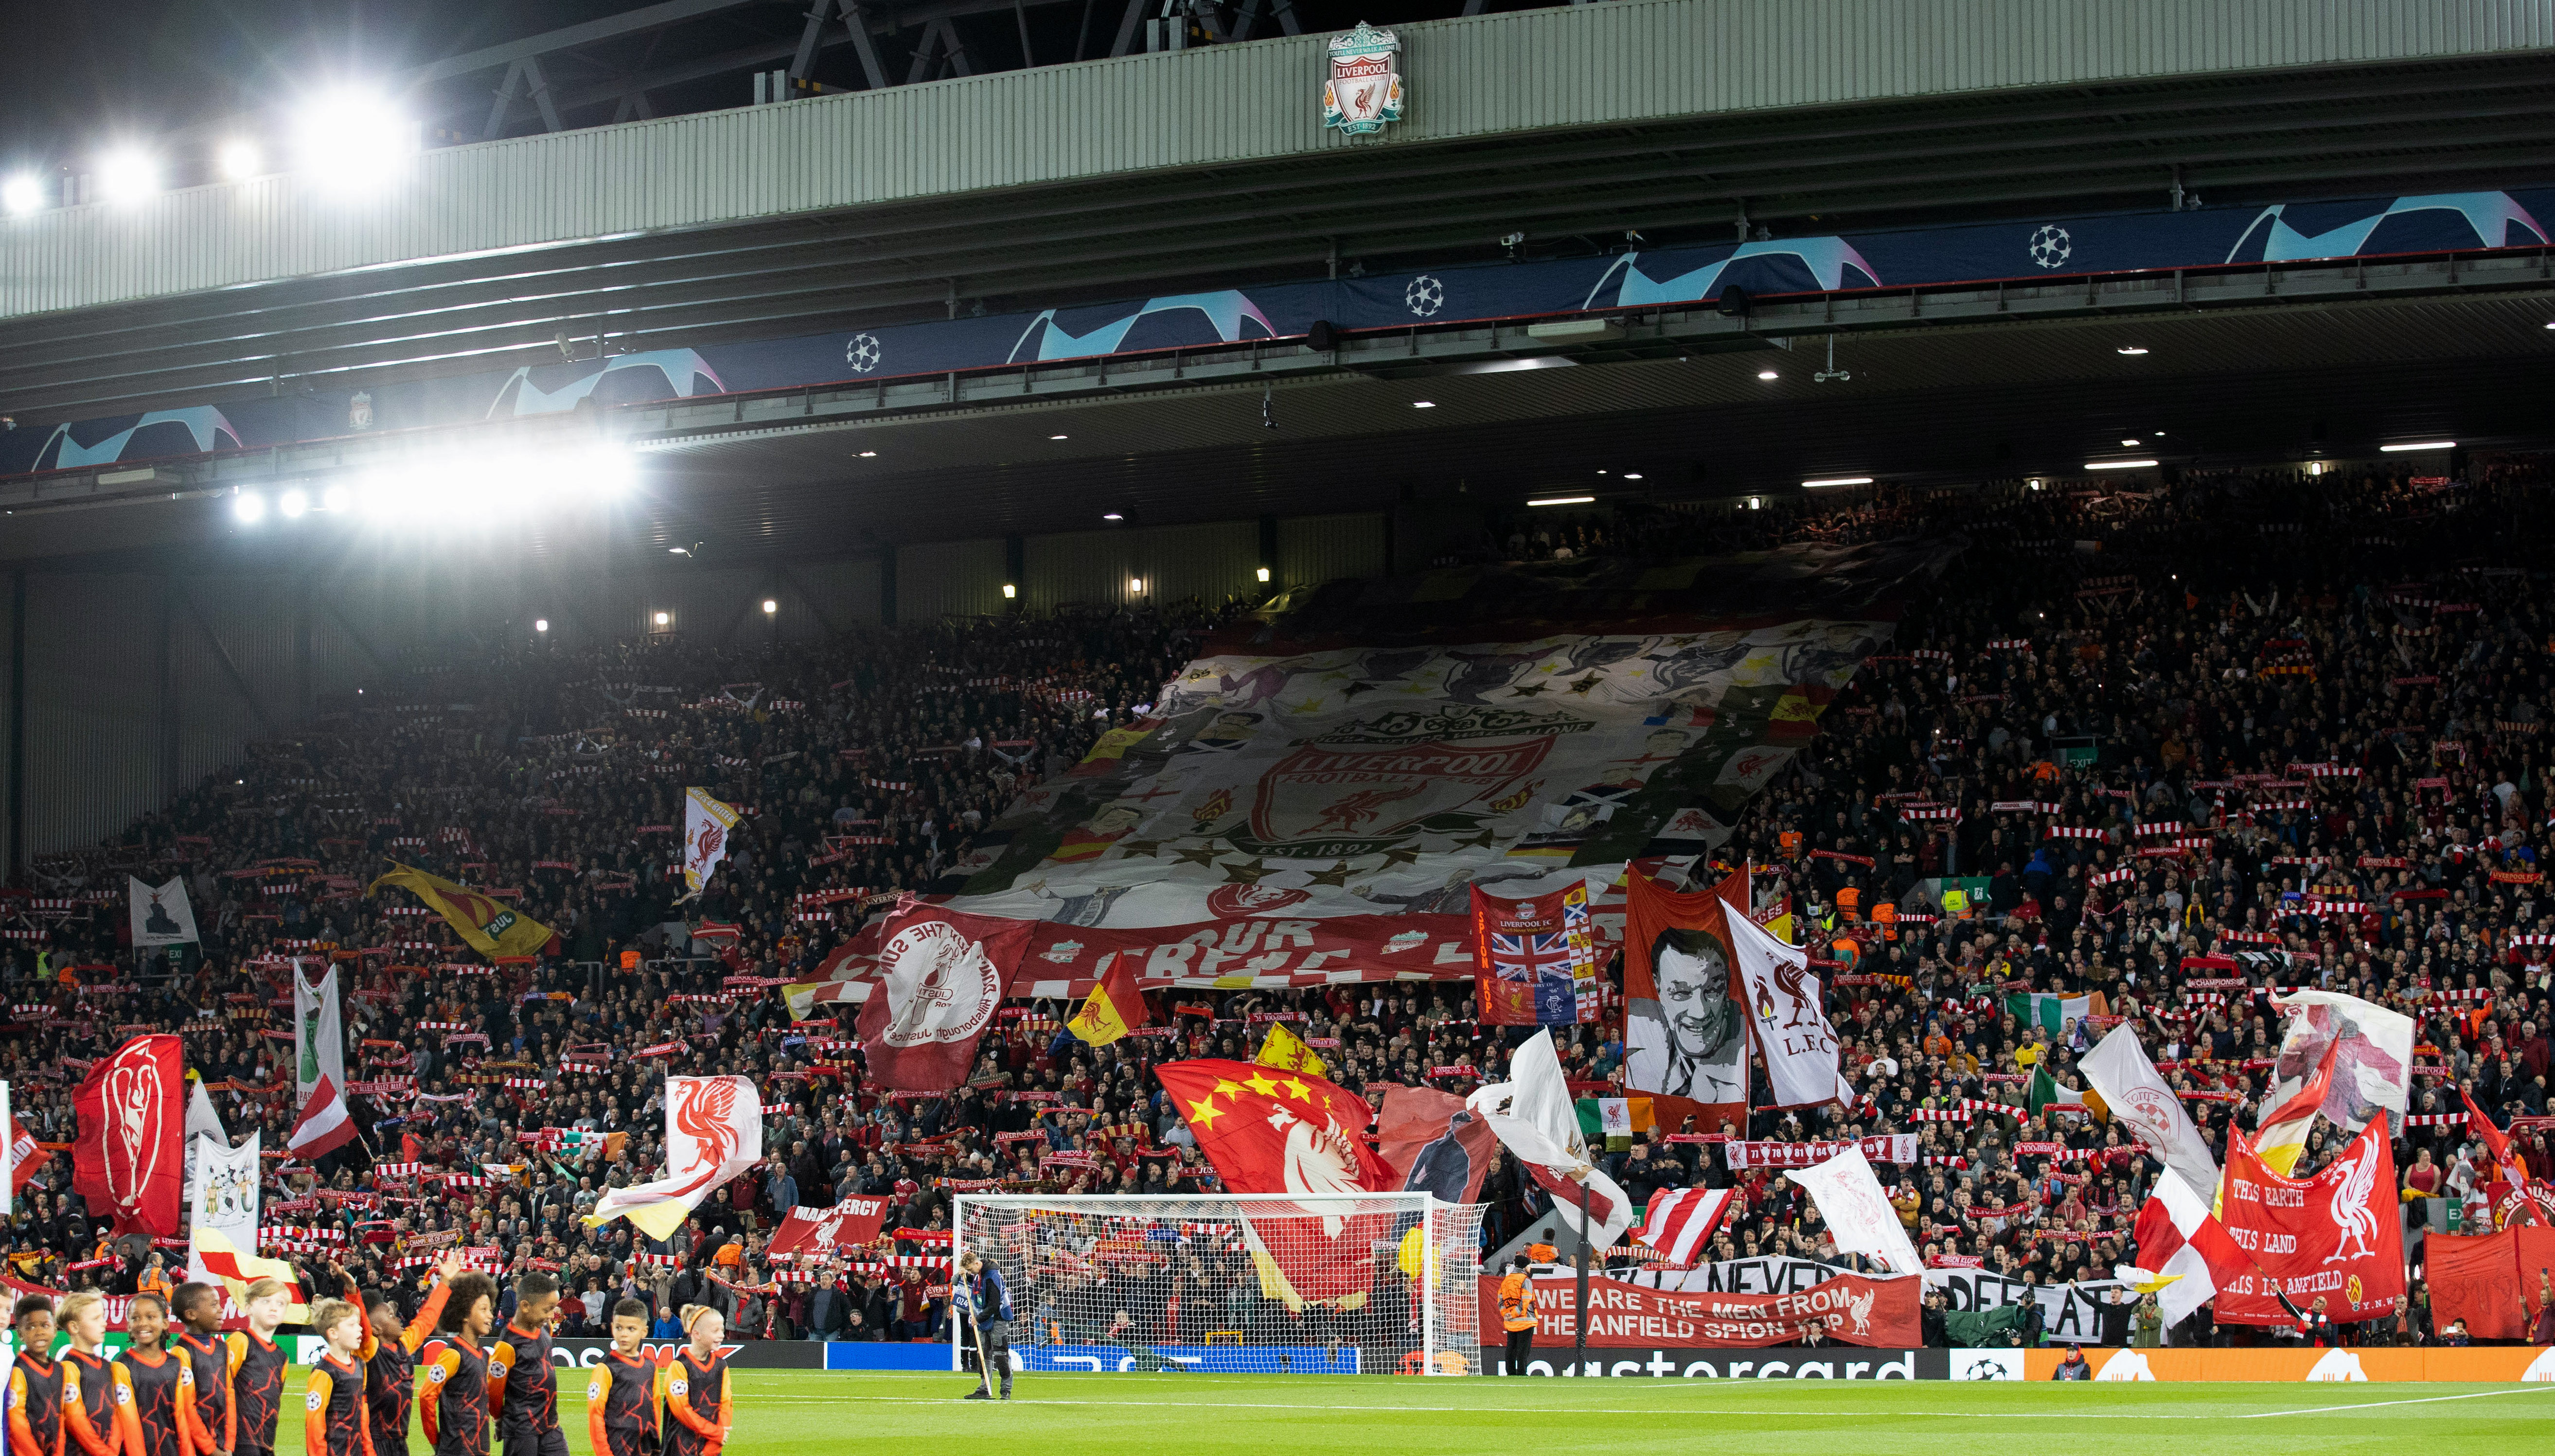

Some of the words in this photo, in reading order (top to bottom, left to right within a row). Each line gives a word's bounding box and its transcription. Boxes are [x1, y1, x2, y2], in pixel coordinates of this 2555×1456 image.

[1363, 46, 1378, 54] WALK
[1378, 44, 1396, 52] ALONE
[1337, 64, 1387, 78] LIVERPOOL
[1339, 77, 1369, 86] FOOTBALL
[1522, 722, 1592, 735] ALONE
[1292, 751, 1523, 774] LIVERPOOL
[2069, 759, 2093, 768] EXIT
[1283, 773, 1416, 784] FOOTBALL
[1816, 850, 1858, 860] LIVERPOOL
[1477, 911, 1490, 969] SPION
[169, 949, 182, 958] EXI
[1482, 978, 1493, 1014] KOP
[643, 1044, 672, 1054] ROBERTSON
[1783, 1033, 1832, 1057] L.F.C
[64, 1056, 93, 1068] LIVERPOOL
[390, 1082, 405, 1090] ALLEZ
[892, 1090, 926, 1098] LIVERPOOL
[998, 1131, 1035, 1140] LIVERPOOL
[1751, 1150, 1759, 1158] 77
[1772, 1149, 1782, 1158] 78
[1794, 1148, 1804, 1157] 81
[1816, 1147, 1827, 1157] 84
[1864, 1143, 1875, 1153] 19
[318, 1188, 355, 1198] LIVERPOOL
[2233, 1178, 2260, 1202] THIS
[2265, 1187, 2304, 1208] EARTH
[277, 1200, 305, 1208] LIVERPOOL
[834, 1199, 882, 1216] PERCY
[1975, 1205, 2025, 1215] LIVERPOOL
[410, 1236, 435, 1246] CHAMPIONS
[442, 1232, 458, 1241] EUROPE
[2230, 1226, 2258, 1250] THIS
[2263, 1232, 2296, 1254] LAND
[72, 1259, 103, 1269] LIVERPOOL
[1707, 1261, 1835, 1294] NEVER
[2223, 1275, 2253, 1296] HIS
[2262, 1277, 2278, 1297] IS
[2287, 1270, 2342, 1296] ANFIELD
[1534, 1288, 1575, 1310] WE
[1588, 1288, 1643, 1311] ARE
[1653, 1298, 1703, 1318] THE
[1712, 1301, 1768, 1320] MEN
[1775, 1286, 1850, 1317] FROM
[1948, 1273, 2109, 1337] DEFAT
[1535, 1315, 1576, 1335] THE
[1588, 1315, 1694, 1339] ANFIELD
[1704, 1321, 1786, 1339] SPION
